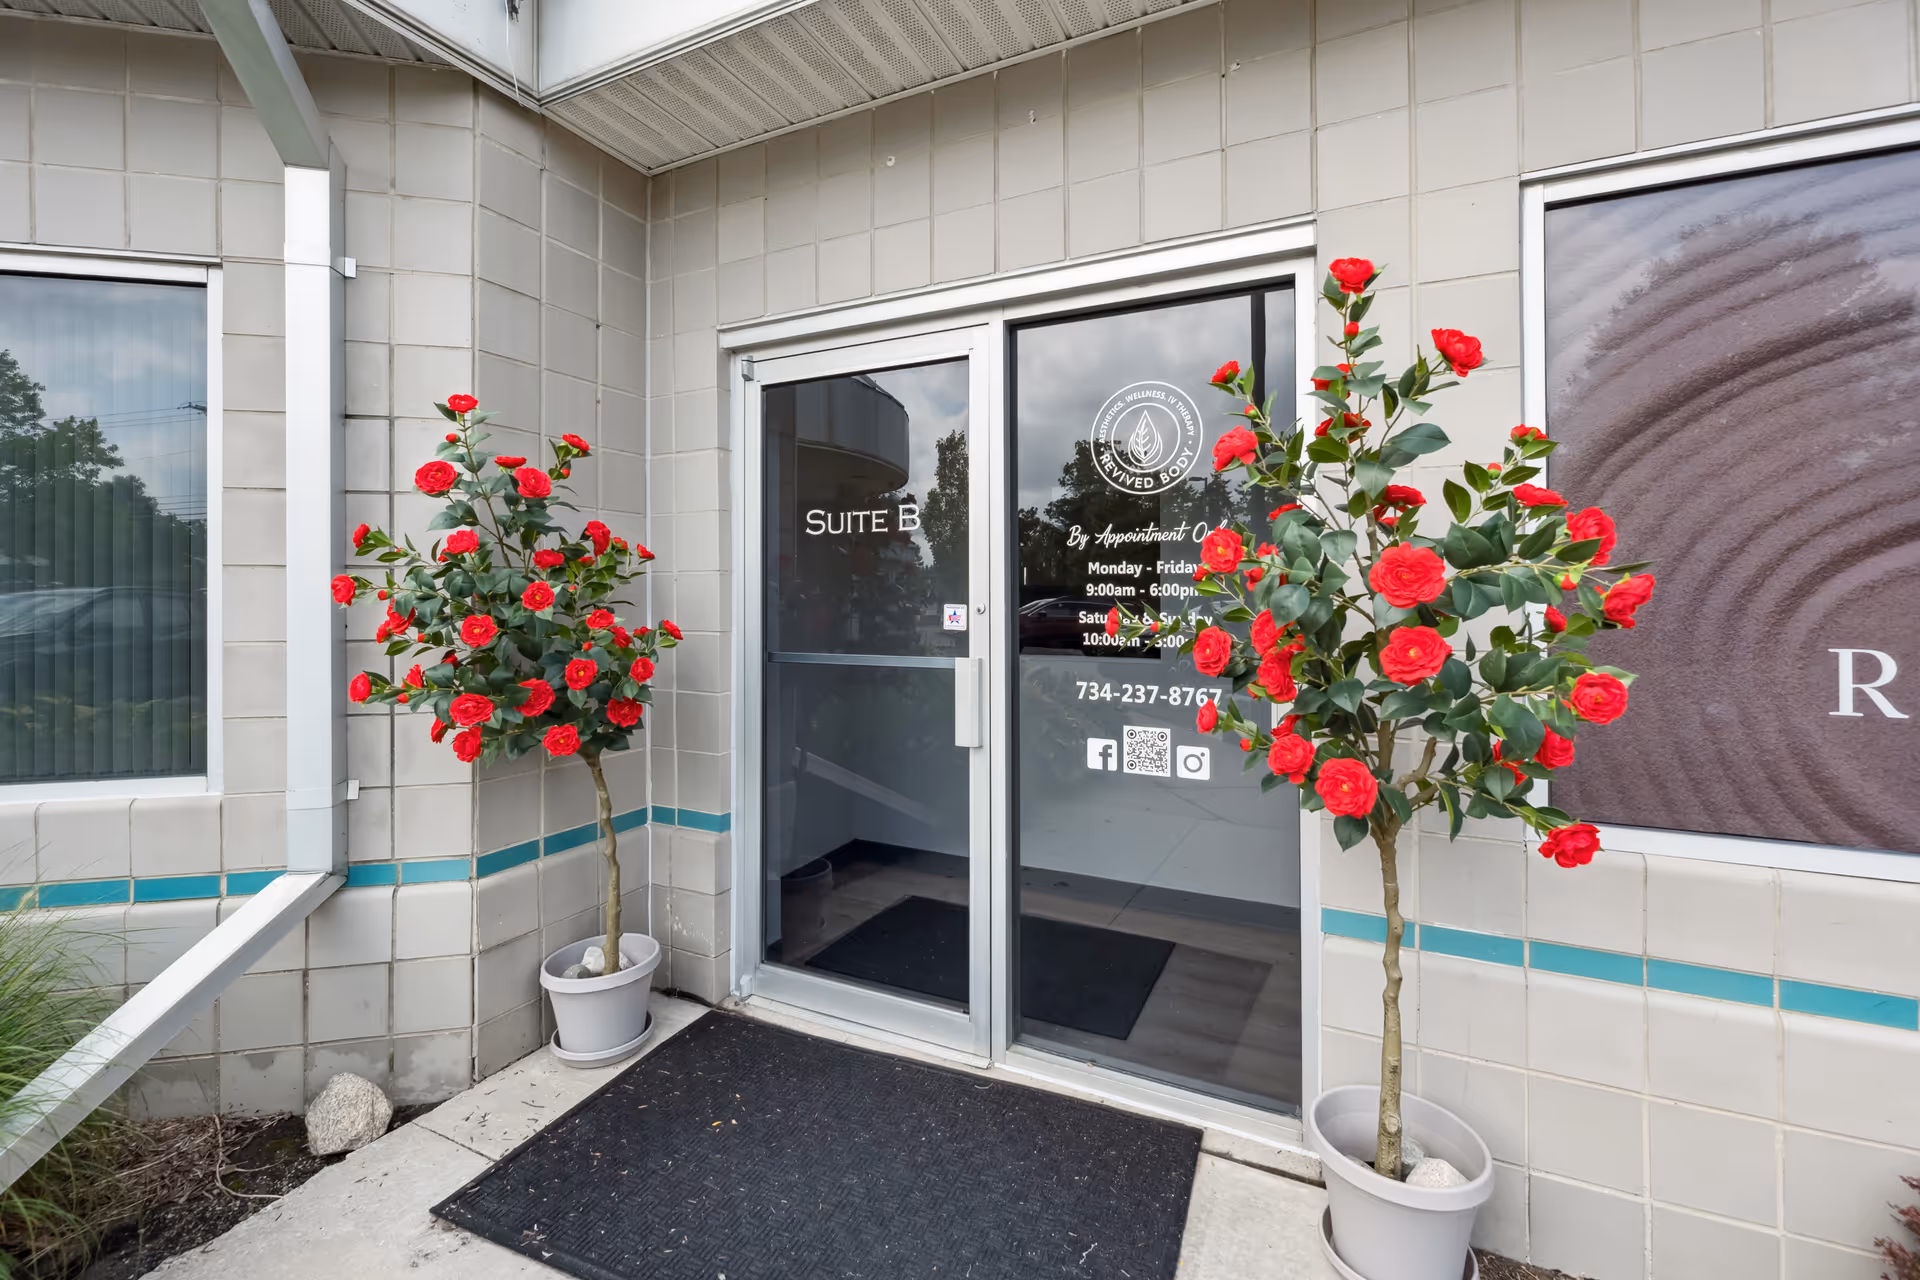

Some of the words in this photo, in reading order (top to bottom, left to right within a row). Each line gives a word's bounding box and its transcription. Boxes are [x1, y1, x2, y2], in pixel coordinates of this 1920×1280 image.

[1167, 395, 1177, 404] IV
[1175, 401, 1195, 436] THERAPY
[1099, 453, 1154, 489] REVIVED
[1159, 447, 1194, 484] BODY
[805, 509, 888, 535] SUITE
[898, 504, 921, 531] B
[1066, 525, 1089, 550] By
[1095, 522, 1191, 548] Appointment
[1088, 561, 1143, 577] Monday
[1086, 583, 1135, 596] 9:00am
[1082, 632, 1140, 647] 10:00am
[1154, 634, 1188, 648] 3:00
[1076, 680, 1222, 707] 734-237-8767
[1828, 648, 1909, 719] R
